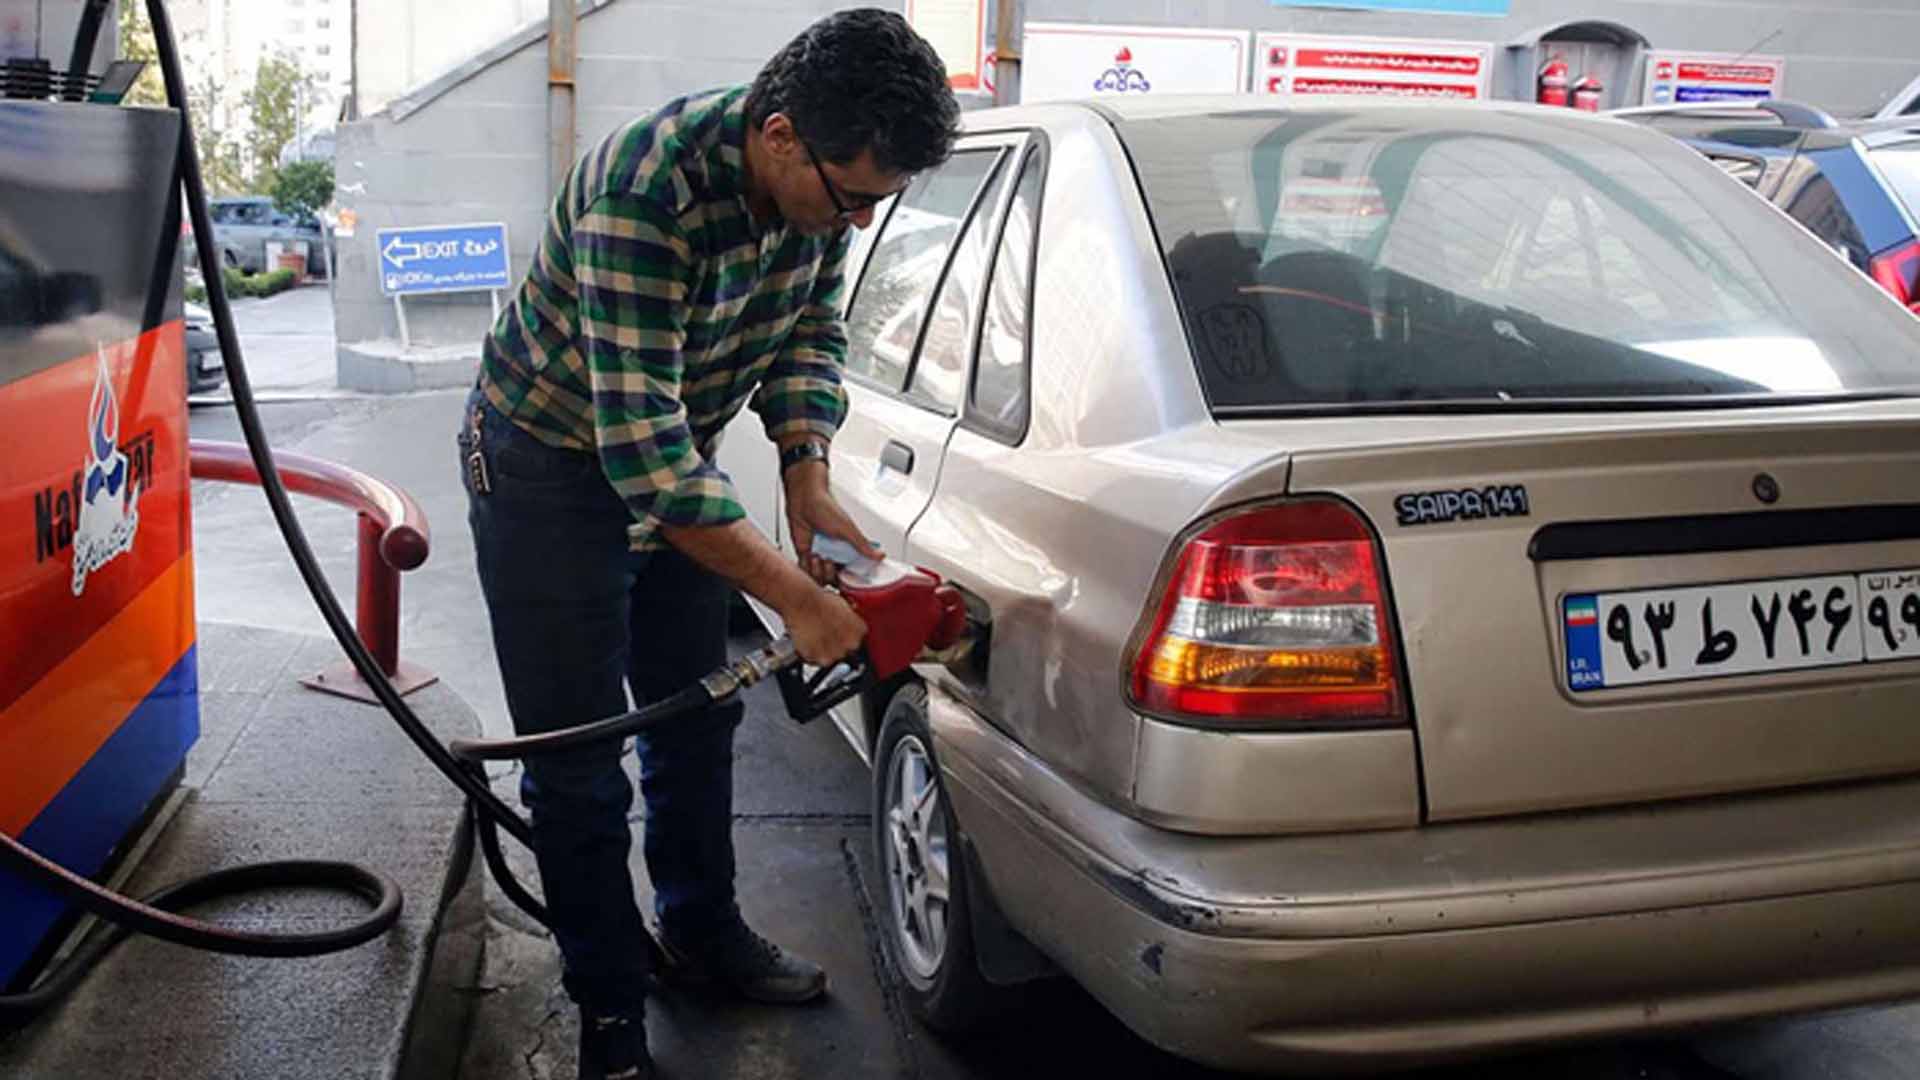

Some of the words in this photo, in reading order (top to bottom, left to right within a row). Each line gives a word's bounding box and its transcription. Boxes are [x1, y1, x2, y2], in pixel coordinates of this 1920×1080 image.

[423, 240, 459, 259] EXIT
[1396, 490, 1483, 524] SAIPA
[1486, 485, 1529, 515] 141
